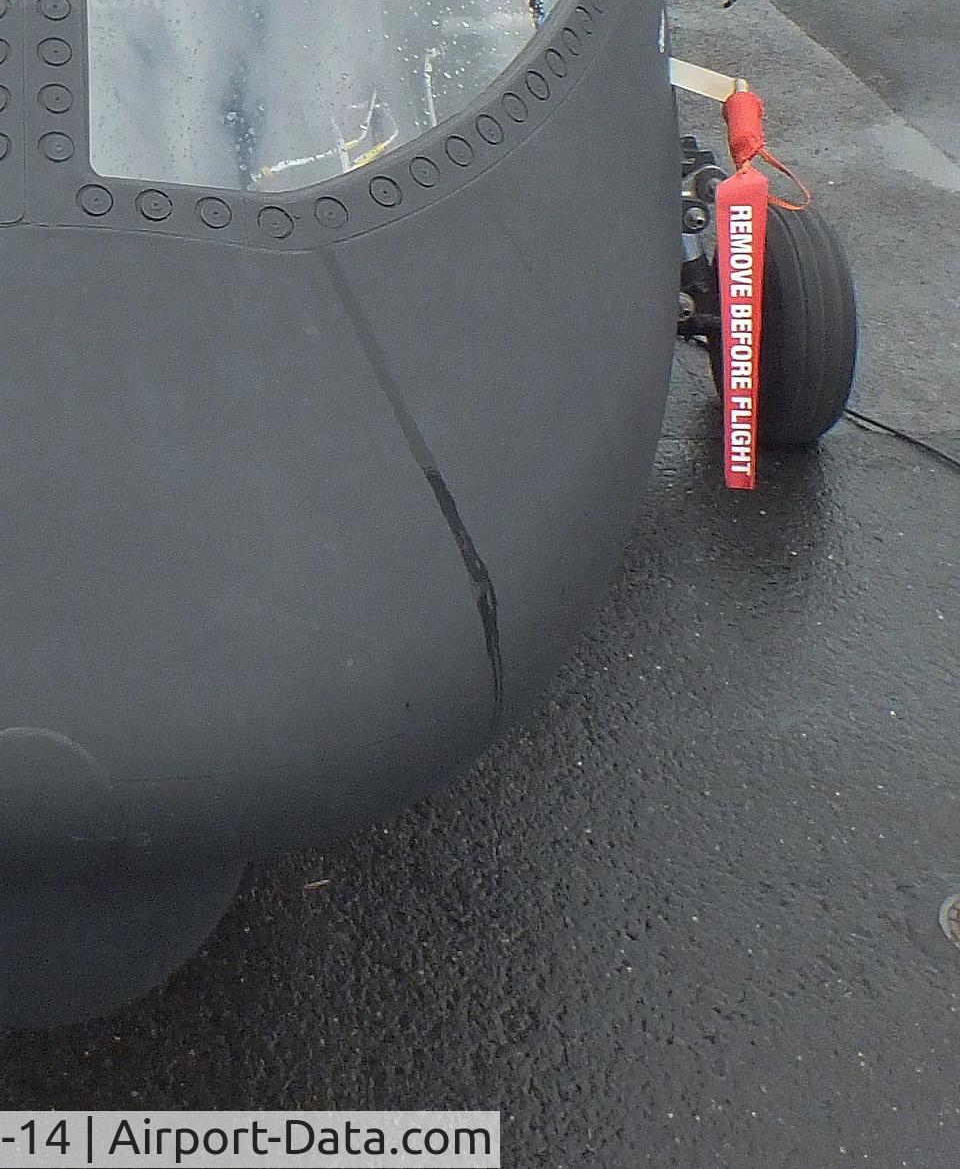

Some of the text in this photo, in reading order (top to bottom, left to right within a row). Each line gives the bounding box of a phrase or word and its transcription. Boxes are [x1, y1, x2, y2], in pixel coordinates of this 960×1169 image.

[729, 205, 753, 476] REMOVE BEFORE FLIGHT
